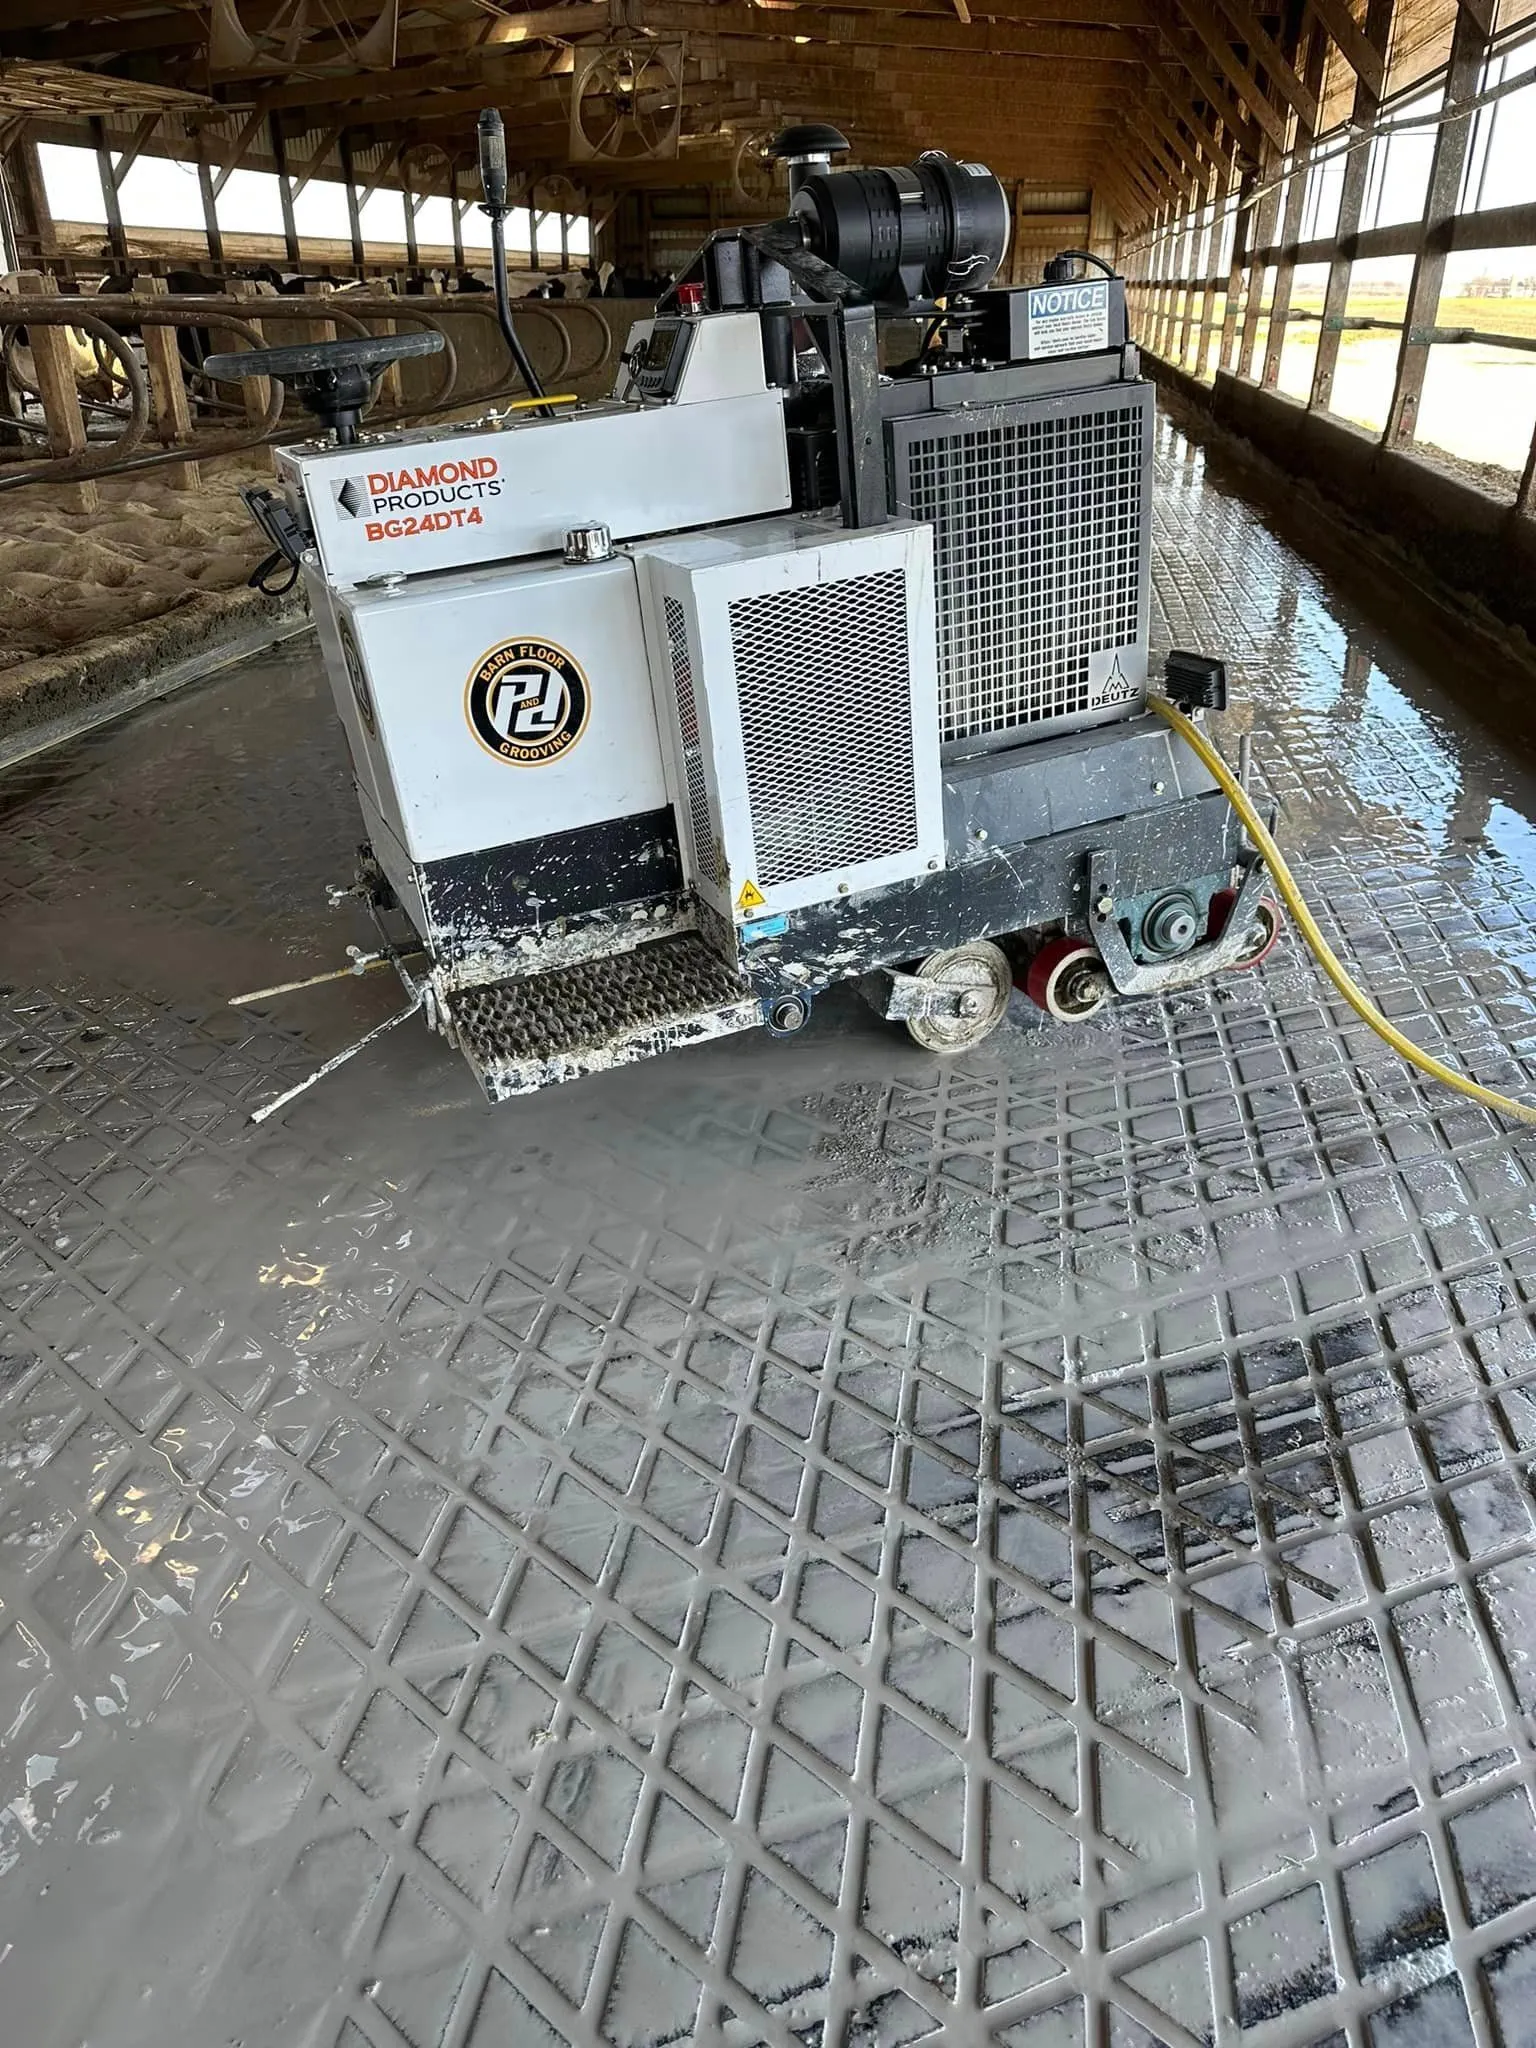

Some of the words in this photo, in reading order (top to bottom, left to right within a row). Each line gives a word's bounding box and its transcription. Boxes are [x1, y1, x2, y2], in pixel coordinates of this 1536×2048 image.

[1032, 286, 1105, 316] NOTICE
[367, 456, 498, 495] DIAMOND
[365, 506, 483, 542] BG24DT4
[480, 648, 516, 682] BARN
[519, 645, 566, 670] FLOOR
[520, 697, 540, 709] AND
[1091, 687, 1139, 706] DEUTZ
[499, 730, 572, 760] GROOVING
